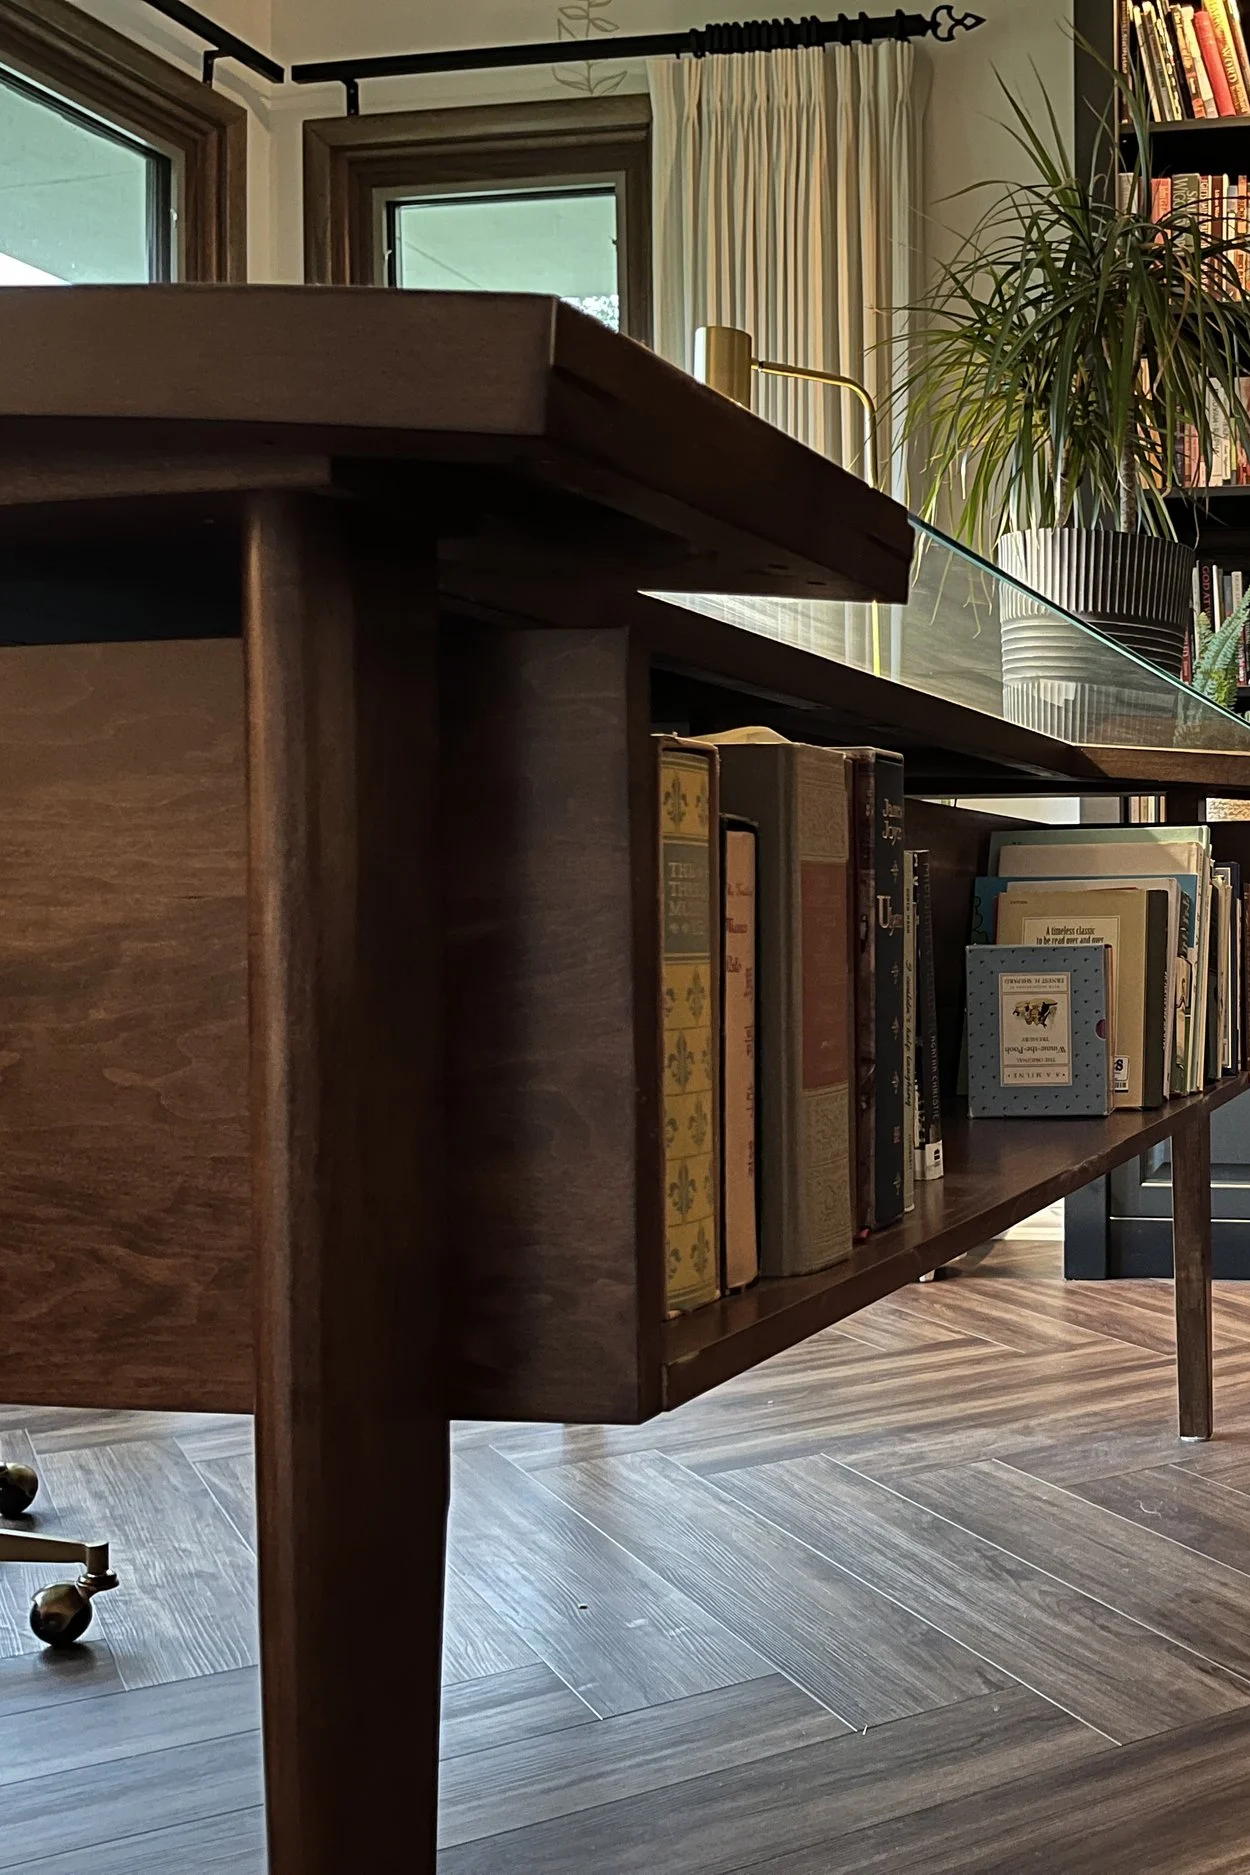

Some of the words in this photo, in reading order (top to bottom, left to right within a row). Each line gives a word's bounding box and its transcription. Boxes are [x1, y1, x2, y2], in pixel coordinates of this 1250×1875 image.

[1221, 46, 1239, 83] WORD
[1202, 566, 1212, 592] GOD
[1204, 593, 1212, 604] AT
[1043, 936, 1051, 944] be
[1051, 936, 1065, 944] read
[1079, 936, 1092, 944] and
[1092, 936, 1105, 944] over
[1051, 926, 1076, 936] timeless
[1076, 926, 1096, 936] classic
[1004, 977, 1034, 985] SHEPARD
[904, 1028, 916, 1054] help
[1004, 1045, 1067, 1054] Winnie-the-Pooh
[905, 1056, 918, 1109] laughing
[932, 1075, 943, 1121] CHRISTIE
